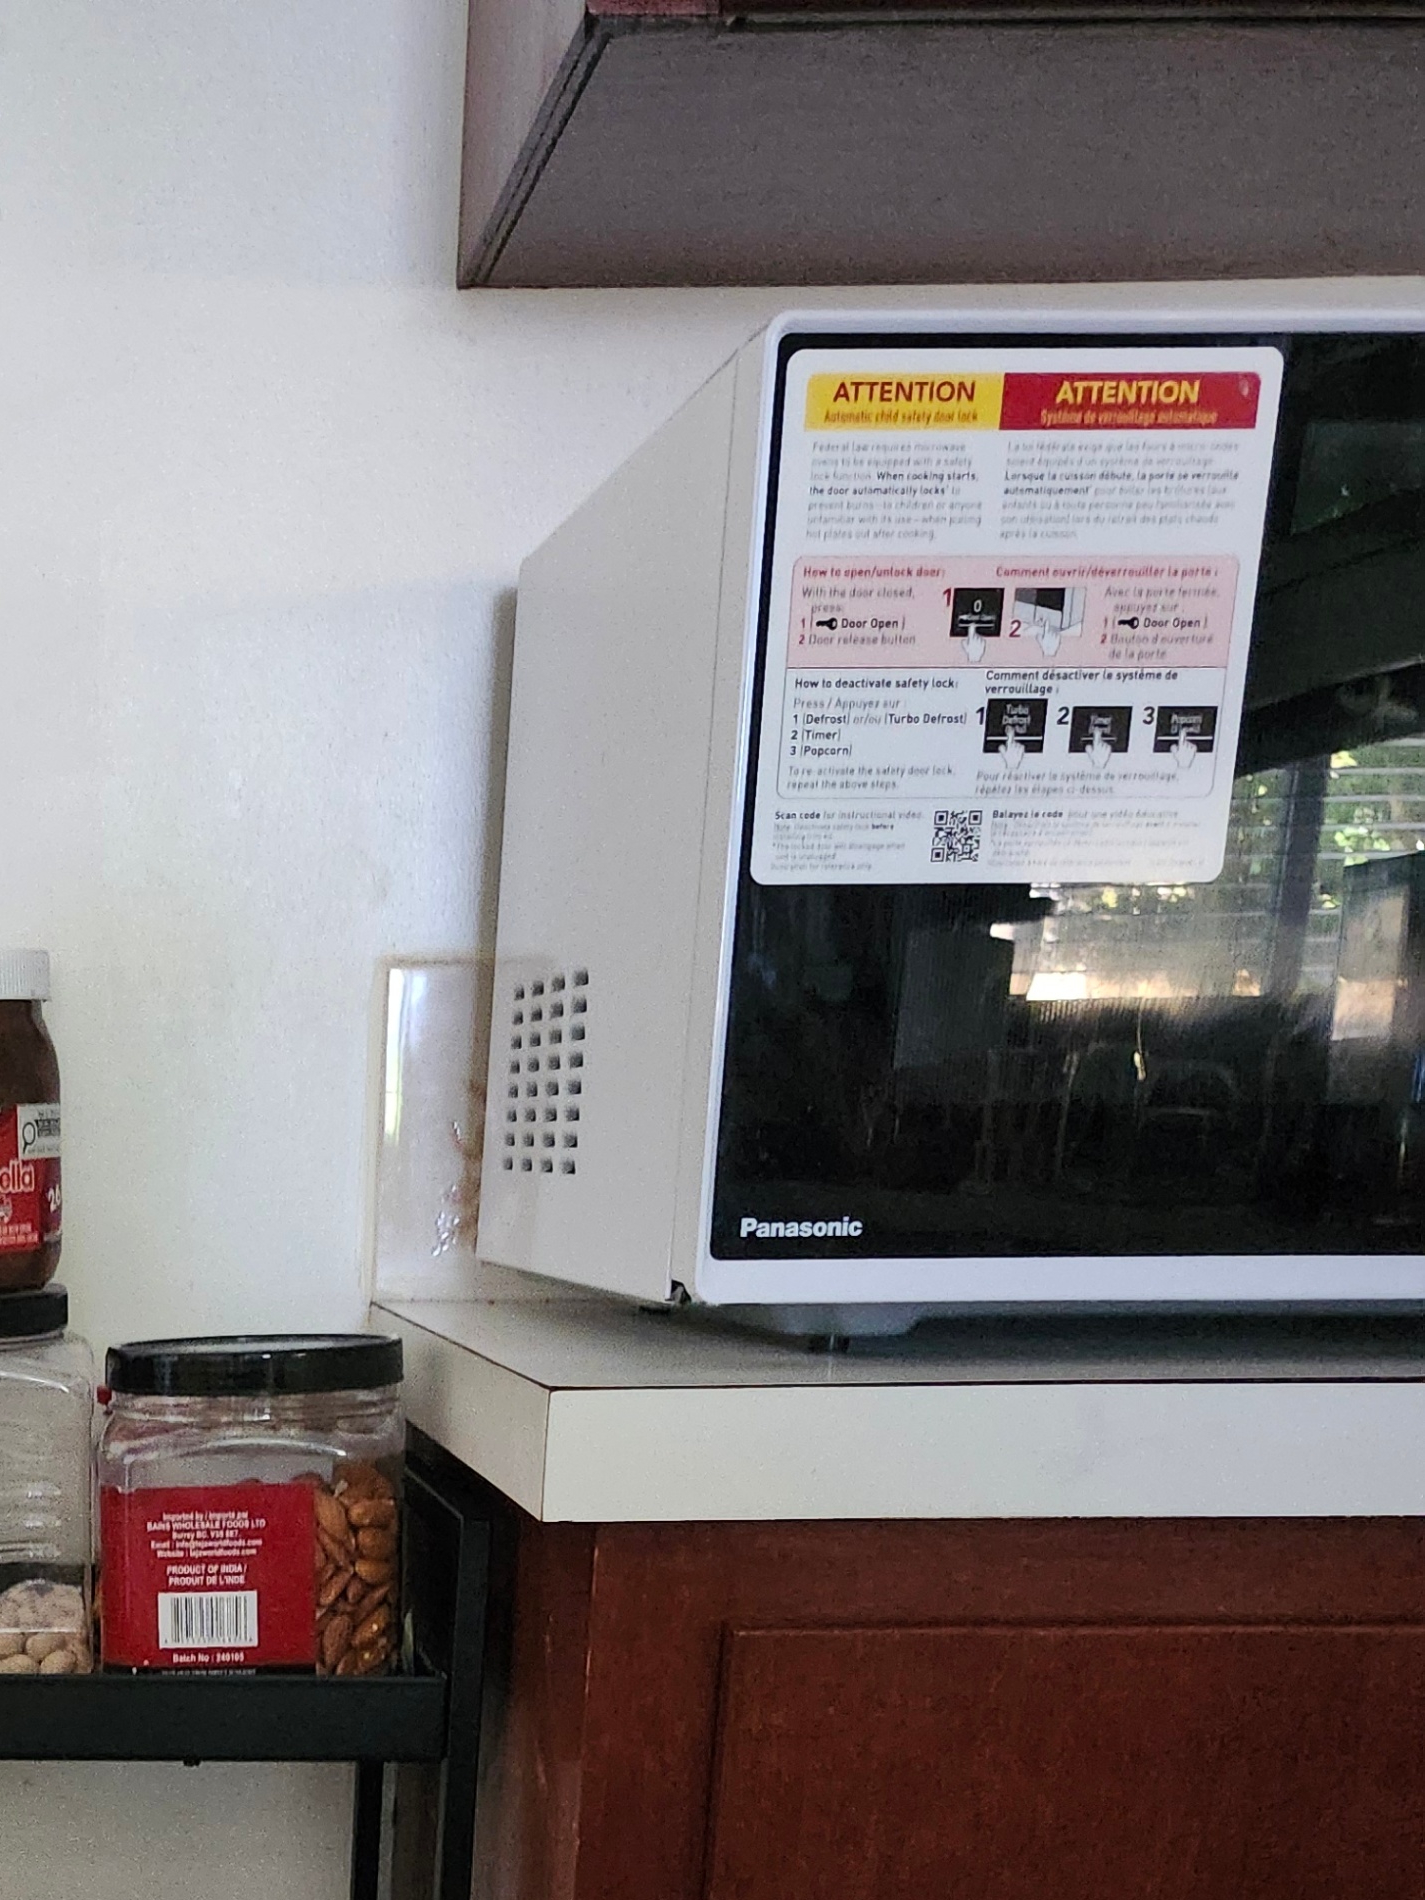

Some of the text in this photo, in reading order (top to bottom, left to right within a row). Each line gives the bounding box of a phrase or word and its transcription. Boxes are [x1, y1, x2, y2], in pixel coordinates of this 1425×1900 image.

[833, 381, 976, 402] ATTENTION
[1056, 380, 1200, 405] ATTENTION
[825, 410, 977, 424] Automatic child safety door lock
[877, 472, 904, 480] When
[907, 472, 943, 482] cooking
[1004, 470, 1044, 483] Lorsque
[1047, 471, 1056, 481] la
[1059, 472, 1096, 481] cuisson
[1137, 471, 1146, 480] la
[1149, 471, 1174, 483] porte
[810, 487, 824, 495] the
[827, 487, 849, 495] door
[853, 486, 917, 497] automatically
[803, 567, 825, 577] How
[830, 567, 840, 577] to
[844, 566, 912, 578] open/unlock
[996, 567, 1049, 577] Comment
[1168, 567, 1177, 577] la
[1180, 567, 1210, 579] porte
[802, 587, 823, 597] With
[829, 587, 845, 597] the
[849, 587, 873, 597] door
[943, 587, 951, 607] 1
[842, 619, 867, 628] Door
[871, 618, 898, 631] Open
[1009, 620, 1022, 638] 2
[1143, 618, 1168, 628] Door
[1172, 618, 1200, 630] Open
[808, 635, 833, 644] Door
[837, 634, 878, 644] release
[881, 634, 915, 644] button
[986, 670, 1178, 682] Comment désactiver le système de
[795, 679, 818, 688] How
[822, 679, 831, 688] to
[835, 679, 892, 688] deactivate
[895, 678, 928, 690] safety
[985, 684, 1052, 695] verrouillage
[794, 698, 824, 708] Press
[834, 697, 879, 710] Appuyez
[975, 707, 1154, 725] 1 2 3
[858, 765, 872, 775] the
[876, 765, 905, 777] safety
[908, 765, 929, 775] door
[822, 779, 836, 788] the
[840, 779, 868, 789] above
[993, 810, 1027, 820] Balayez
[1031, 810, 1039, 818] le
[740, 1216, 863, 1237] Panasonic
[172, 1520, 220, 1531] WHOLESALE
[251, 1519, 266, 1529] LTD
[167, 1565, 205, 1576] PRODUCT
[208, 1565, 218, 1573] OF
[220, 1563, 242, 1573] INDIA
[169, 1575, 205, 1587] PRODUIT
[206, 1575, 217, 1585] DE
[173, 1653, 195, 1663] Batch
[198, 1653, 209, 1661] No
